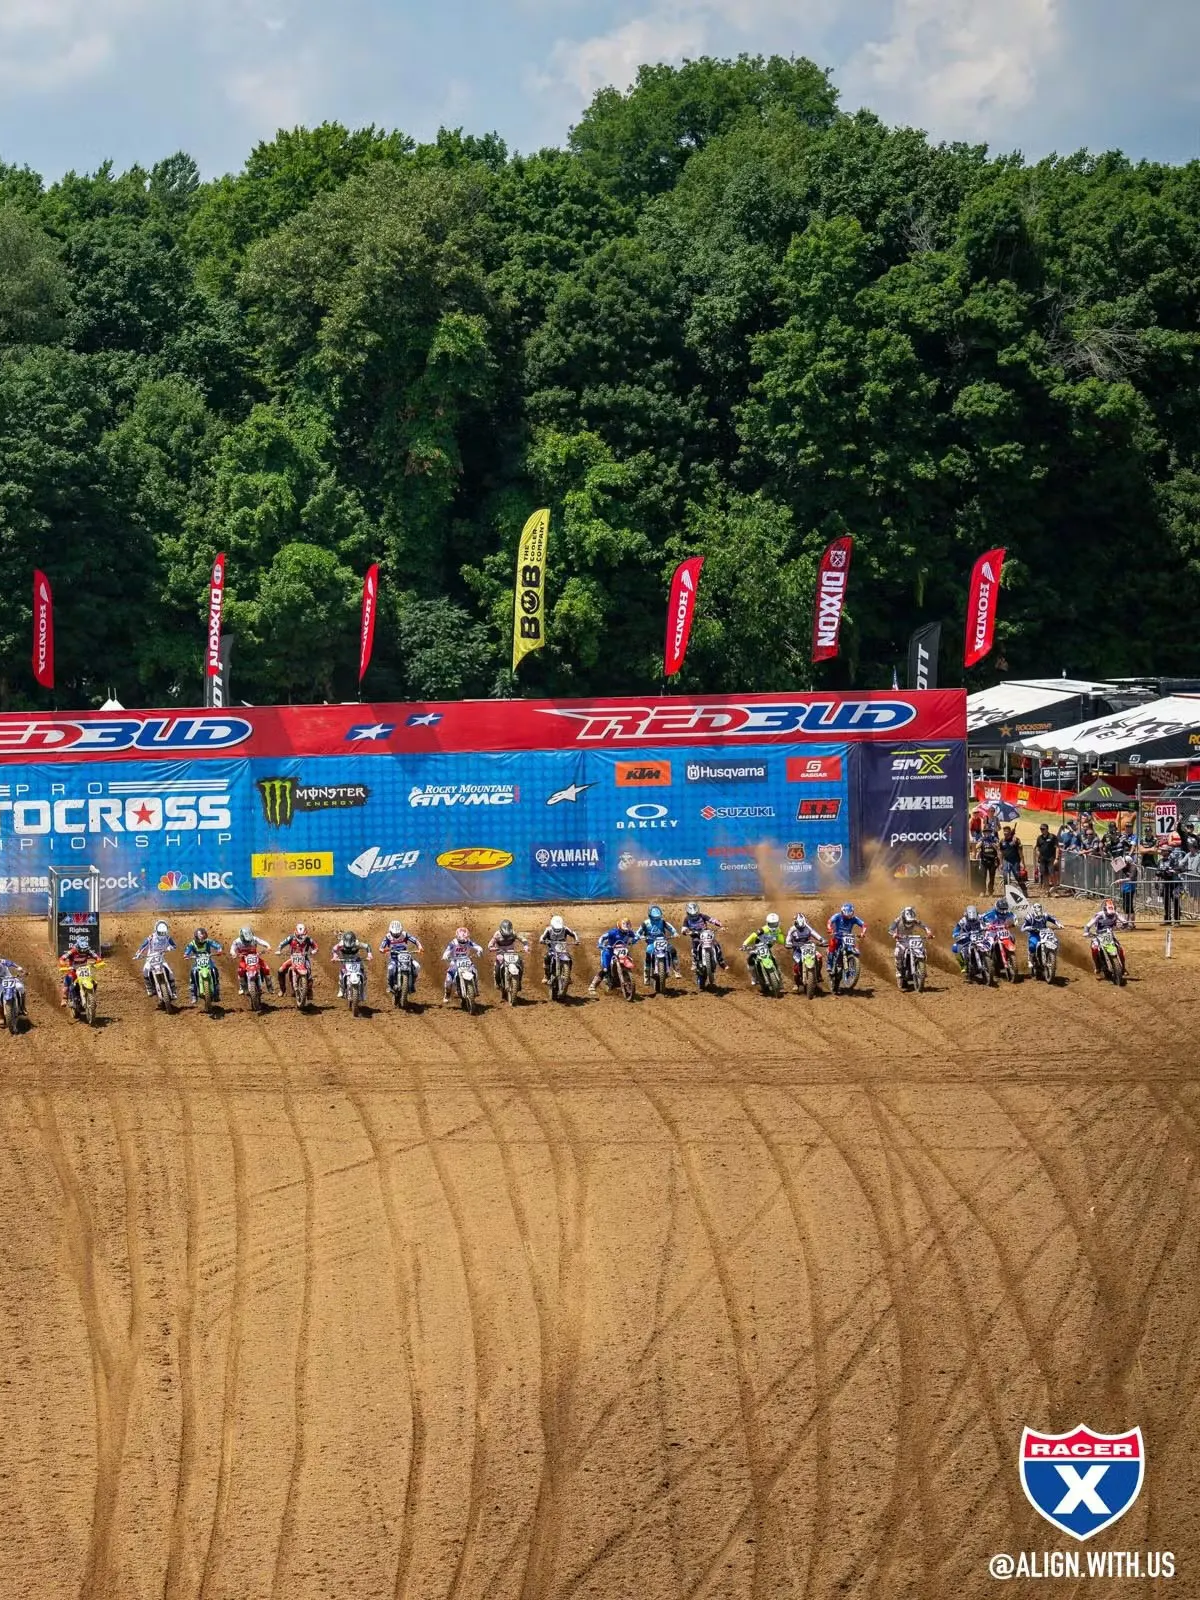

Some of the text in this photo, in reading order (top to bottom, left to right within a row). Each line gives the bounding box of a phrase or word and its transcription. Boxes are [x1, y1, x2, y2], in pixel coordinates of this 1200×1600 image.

[530, 529, 538, 562] COOLER
[536, 521, 545, 562] COMPANY
[520, 564, 541, 639] BOB
[817, 571, 845, 647] DIXXON
[974, 582, 990, 652] HONDA
[209, 588, 222, 667] DIXXON
[674, 590, 689, 660] HONDA
[38, 605, 46, 674] HONDA
[532, 700, 917, 740] REDBUD
[891, 754, 946, 774] SMX
[625, 767, 661, 780] KTM
[700, 765, 765, 779] Husqvarna
[16, 782, 103, 797] PRO
[295, 786, 366, 800] MONSTER
[425, 784, 457, 794] ROCKY
[458, 784, 513, 794] MOUNTAIN
[889, 796, 931, 811] AMA
[931, 796, 953, 805] PRO
[717, 806, 775, 818] SUZUKI
[1156, 806, 1176, 816] GATE
[616, 819, 680, 829] OAKLEY
[1157, 816, 1176, 833] 12
[891, 828, 947, 847] peacock
[374, 850, 420, 867] UFO
[438, 850, 513, 868] FMF
[550, 848, 599, 862] YAMAHA
[637, 858, 701, 867] MARINES
[371, 863, 416, 874] PLAST
[920, 864, 949, 878] NBC
[21, 876, 49, 887] PRO
[193, 871, 234, 890] NBC
[69, 926, 90, 934] Rights.
[1040, 932, 1053, 940] 72
